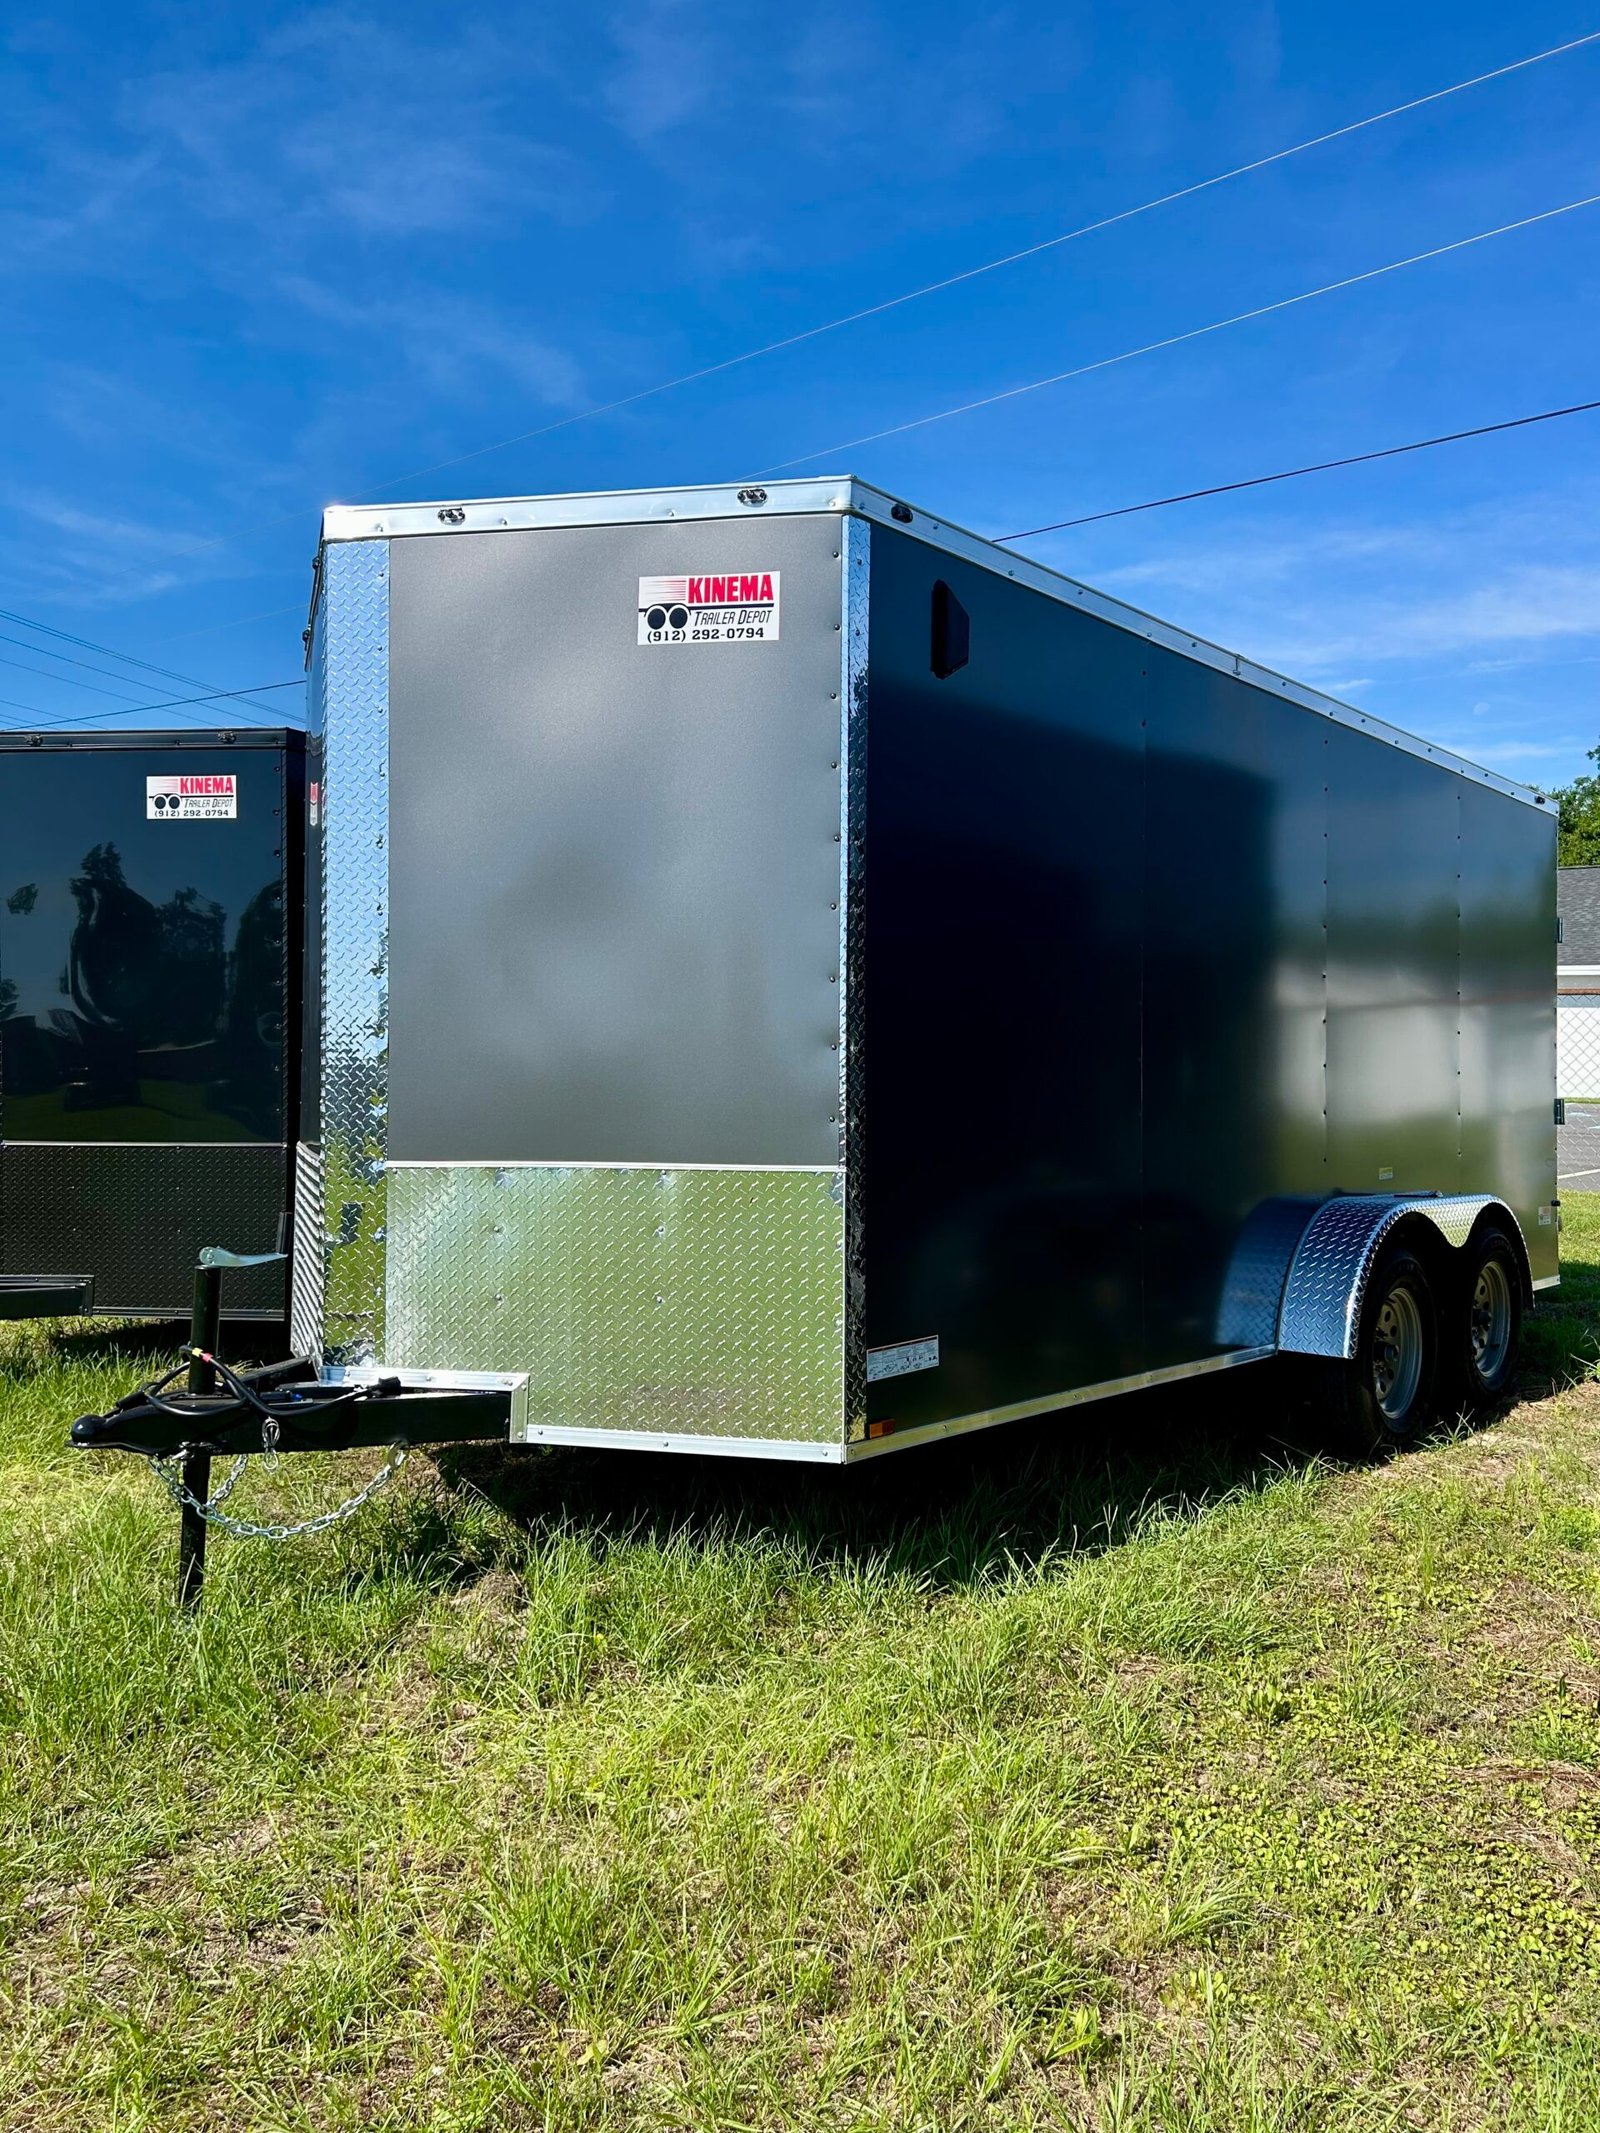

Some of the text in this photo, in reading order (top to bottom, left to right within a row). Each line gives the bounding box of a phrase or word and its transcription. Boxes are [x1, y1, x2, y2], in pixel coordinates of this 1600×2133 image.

[688, 574, 774, 604] KINEMA
[647, 627, 764, 644] (912) 292-0794
[180, 777, 233, 794] KINEMA
[154, 809, 229, 817] (912) 292-0794
